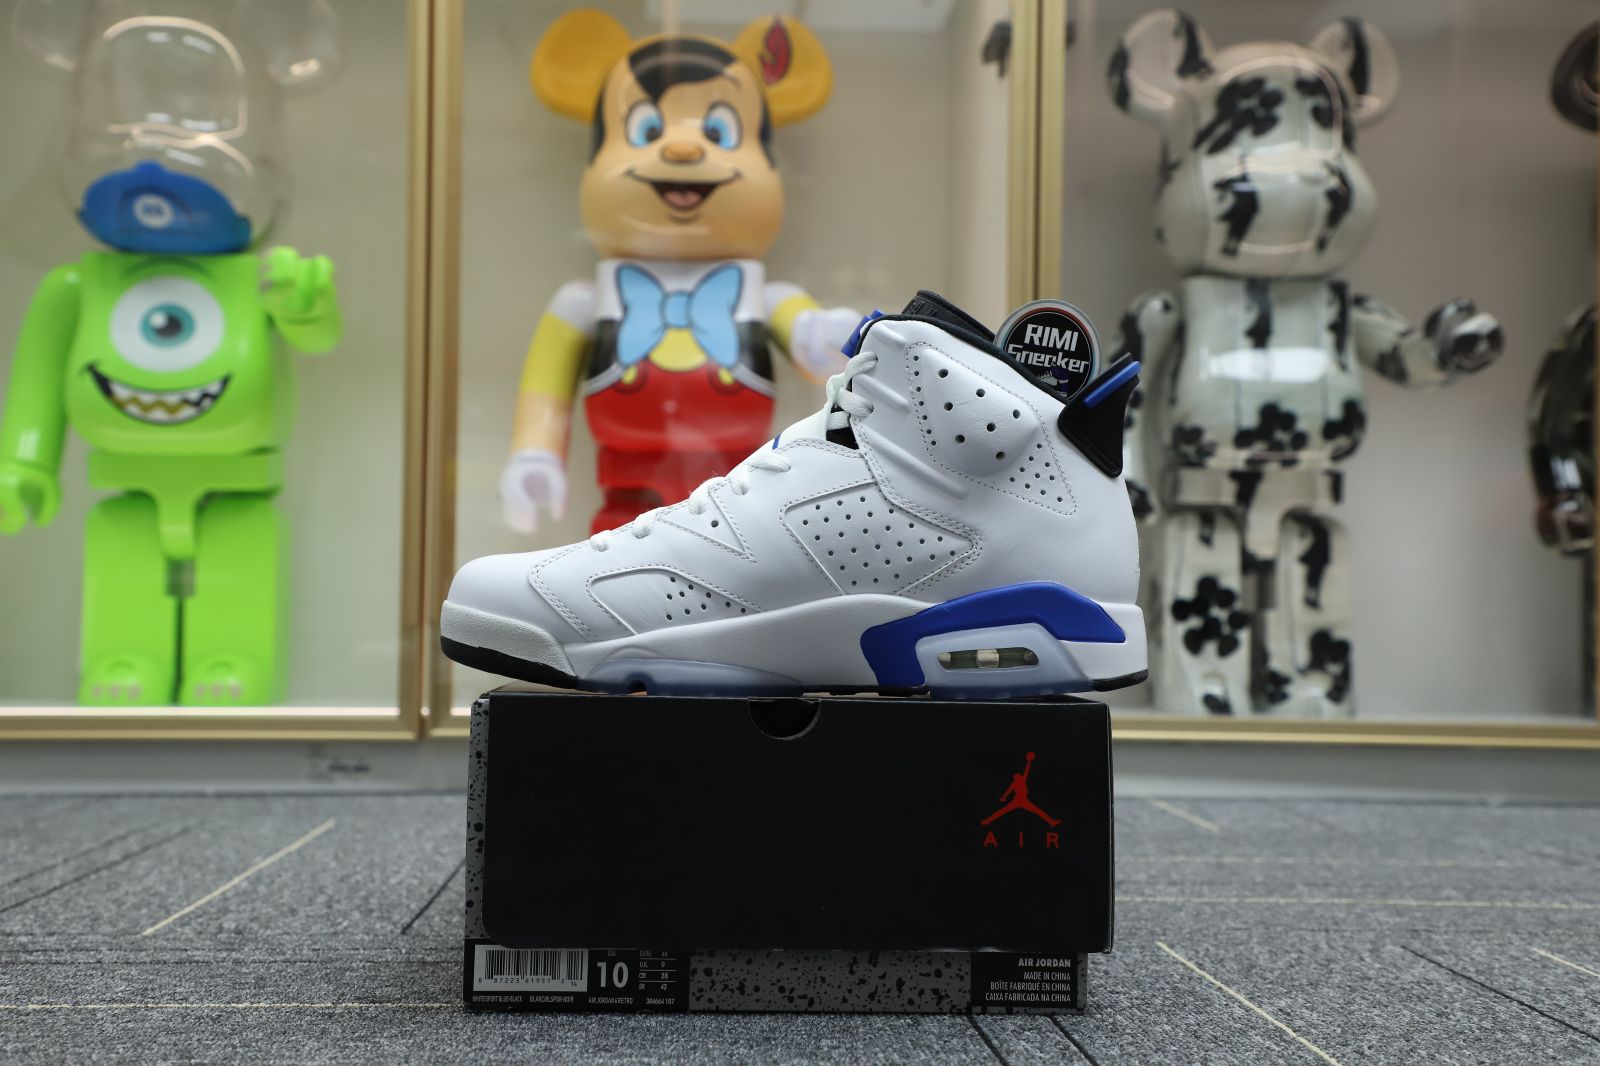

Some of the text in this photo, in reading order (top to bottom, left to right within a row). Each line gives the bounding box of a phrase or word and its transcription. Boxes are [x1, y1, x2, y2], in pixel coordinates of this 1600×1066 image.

[1024, 323, 1079, 352] RIMI
[983, 831, 1060, 849] AIR
[1018, 958, 1071, 967] AIR JORDAN
[597, 962, 628, 988] 10
[661, 972, 669, 980] 28
[1024, 971, 1071, 980] MADE IN CHINA
[1042, 983, 1050, 991] EN
[1051, 983, 1071, 991] CHINA
[985, 993, 1071, 1002] CAIXA FABRICADA NA CHINA
